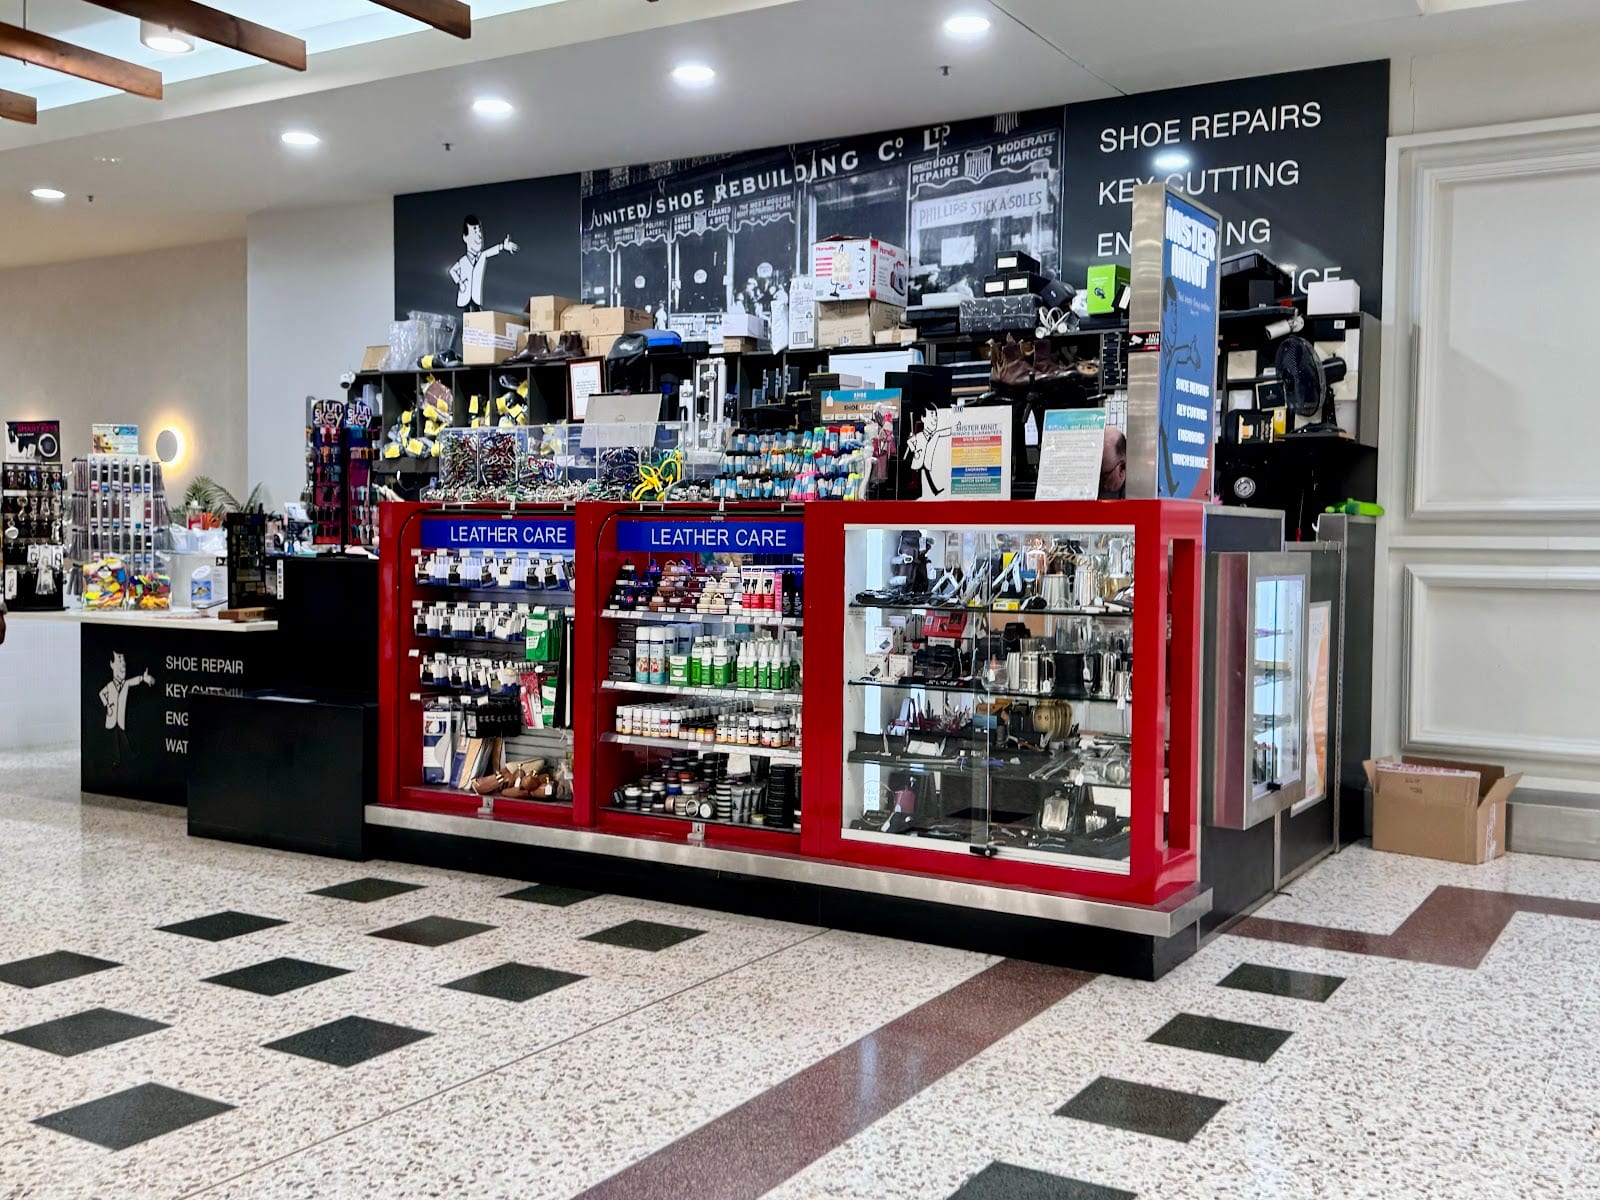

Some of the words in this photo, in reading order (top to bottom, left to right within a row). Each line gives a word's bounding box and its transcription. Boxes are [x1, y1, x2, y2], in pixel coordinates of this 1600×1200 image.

[1099, 119, 1181, 153] SHOE
[1190, 101, 1322, 141] REPAIRS
[997, 132, 1056, 155] MODERATE
[1000, 146, 1053, 166] CHARGES
[912, 165, 959, 184] REPAIRS
[593, 203, 647, 228] UNITED
[656, 189, 705, 214] SHOE
[714, 149, 859, 204] REBUILDING
[707, 206, 732, 218] CLEANED
[919, 201, 968, 228] PHILLIPS
[1165, 204, 1217, 262] MISTER
[323, 400, 342, 413] fun
[356, 400, 371, 416] fun
[320, 410, 344, 427] key
[352, 411, 371, 428] key
[450, 525, 517, 543] LEATHER
[522, 527, 567, 544] CARE
[650, 528, 729, 546] LEATHER
[735, 529, 787, 547] CARE
[165, 655, 198, 671] SHOE
[201, 658, 243, 674] REPAIR
[165, 683, 188, 698] KEY
